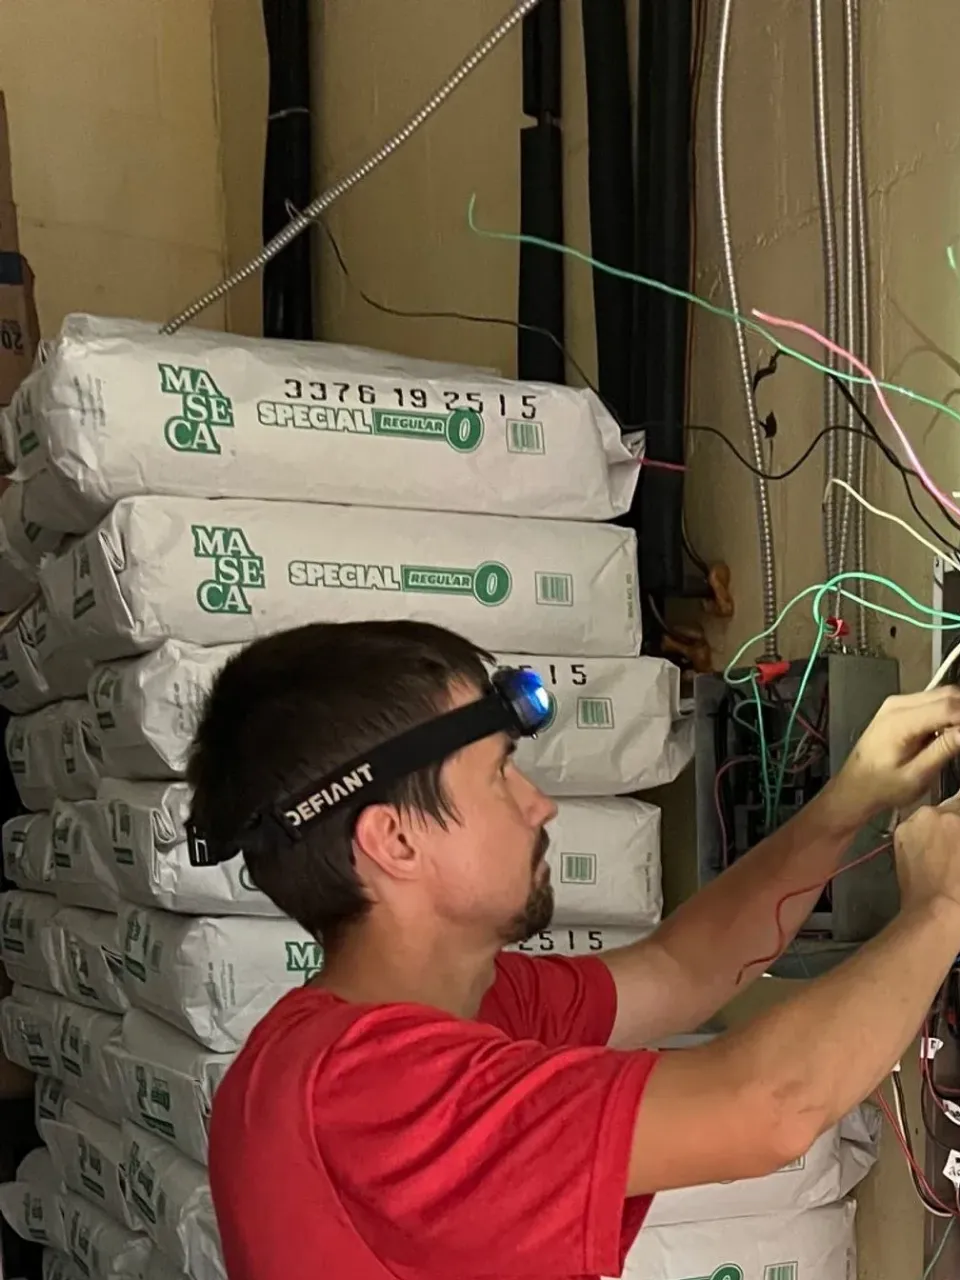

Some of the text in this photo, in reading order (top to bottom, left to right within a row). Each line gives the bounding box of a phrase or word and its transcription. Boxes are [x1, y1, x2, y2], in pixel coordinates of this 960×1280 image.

[284, 378, 376, 405] 3376
[257, 400, 372, 434] SPECIAL
[380, 414, 446, 434] REGULAR
[288, 560, 400, 590] SPECIAL
[408, 571, 473, 588] REGULAR
[285, 941, 323, 971] M
